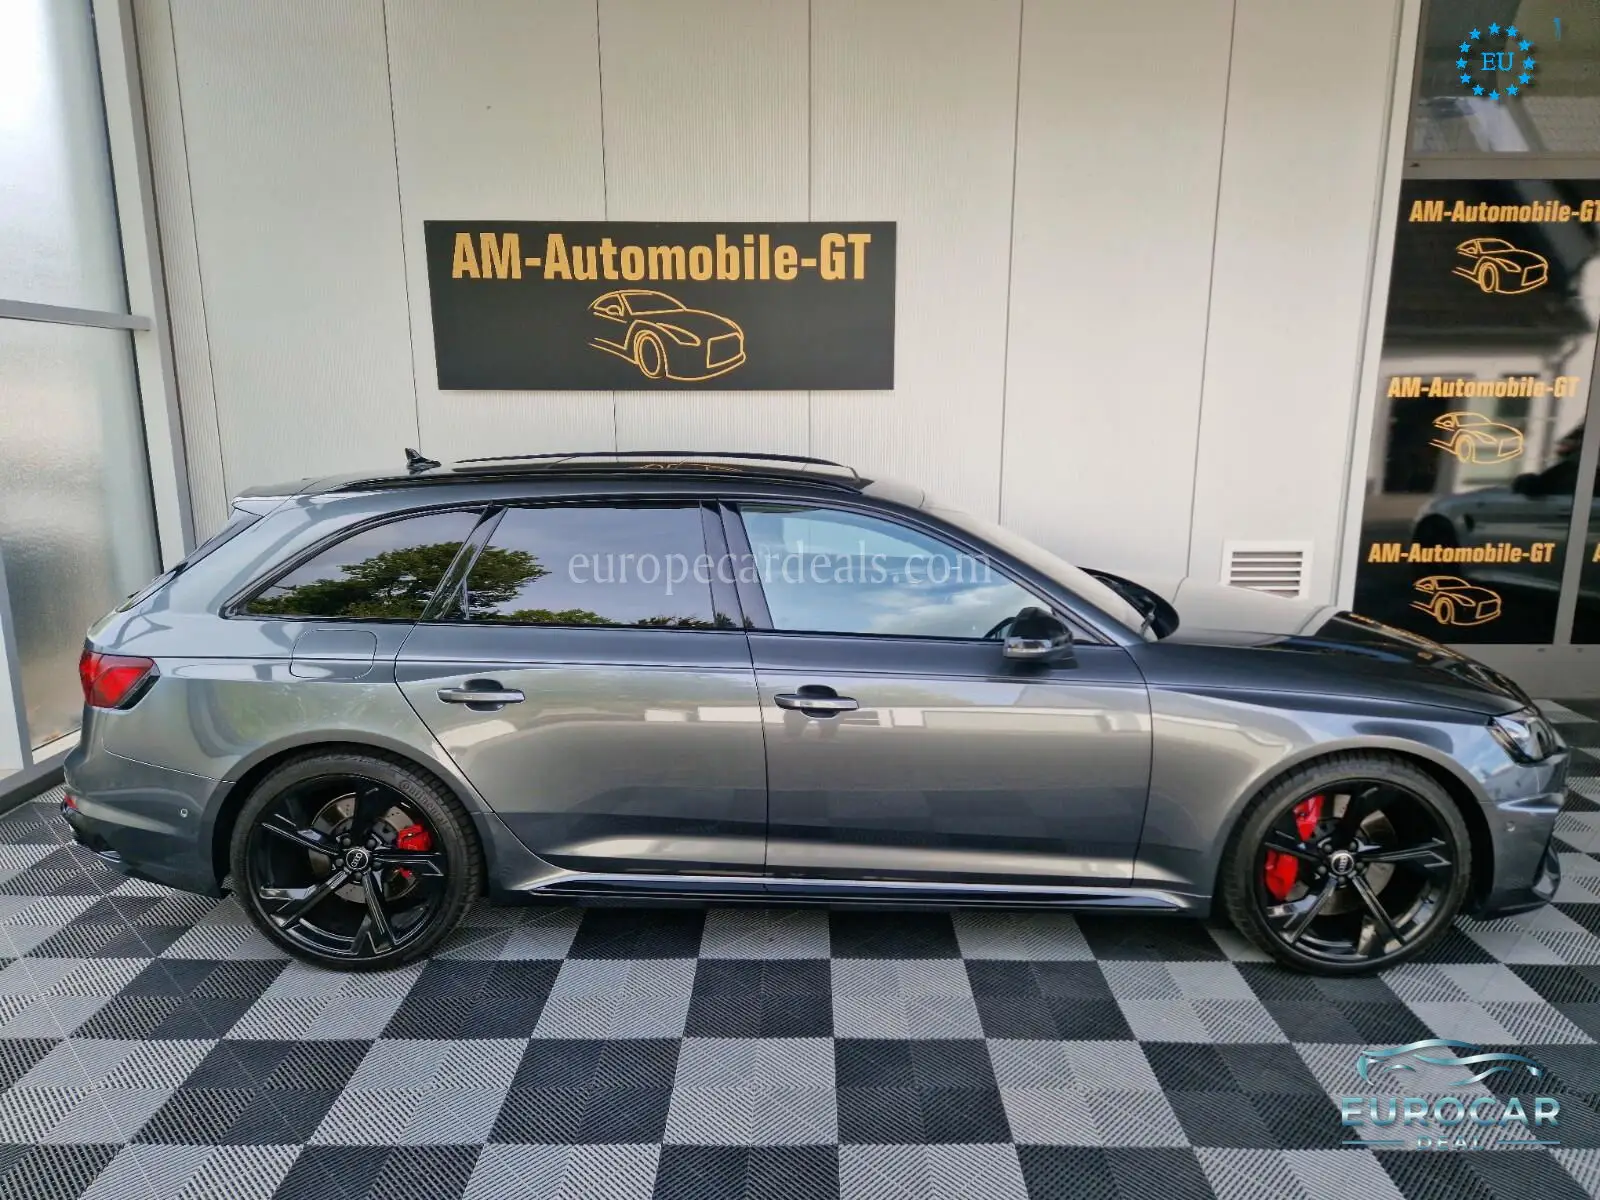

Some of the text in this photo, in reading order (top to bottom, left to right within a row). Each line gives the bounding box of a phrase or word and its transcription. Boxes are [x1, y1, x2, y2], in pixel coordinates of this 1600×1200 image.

[452, 231, 873, 281] AM-Automobile-GT
[1387, 376, 1582, 398] AM-Automobile-GT
[1368, 543, 1555, 563] AM-Automobile-GT
